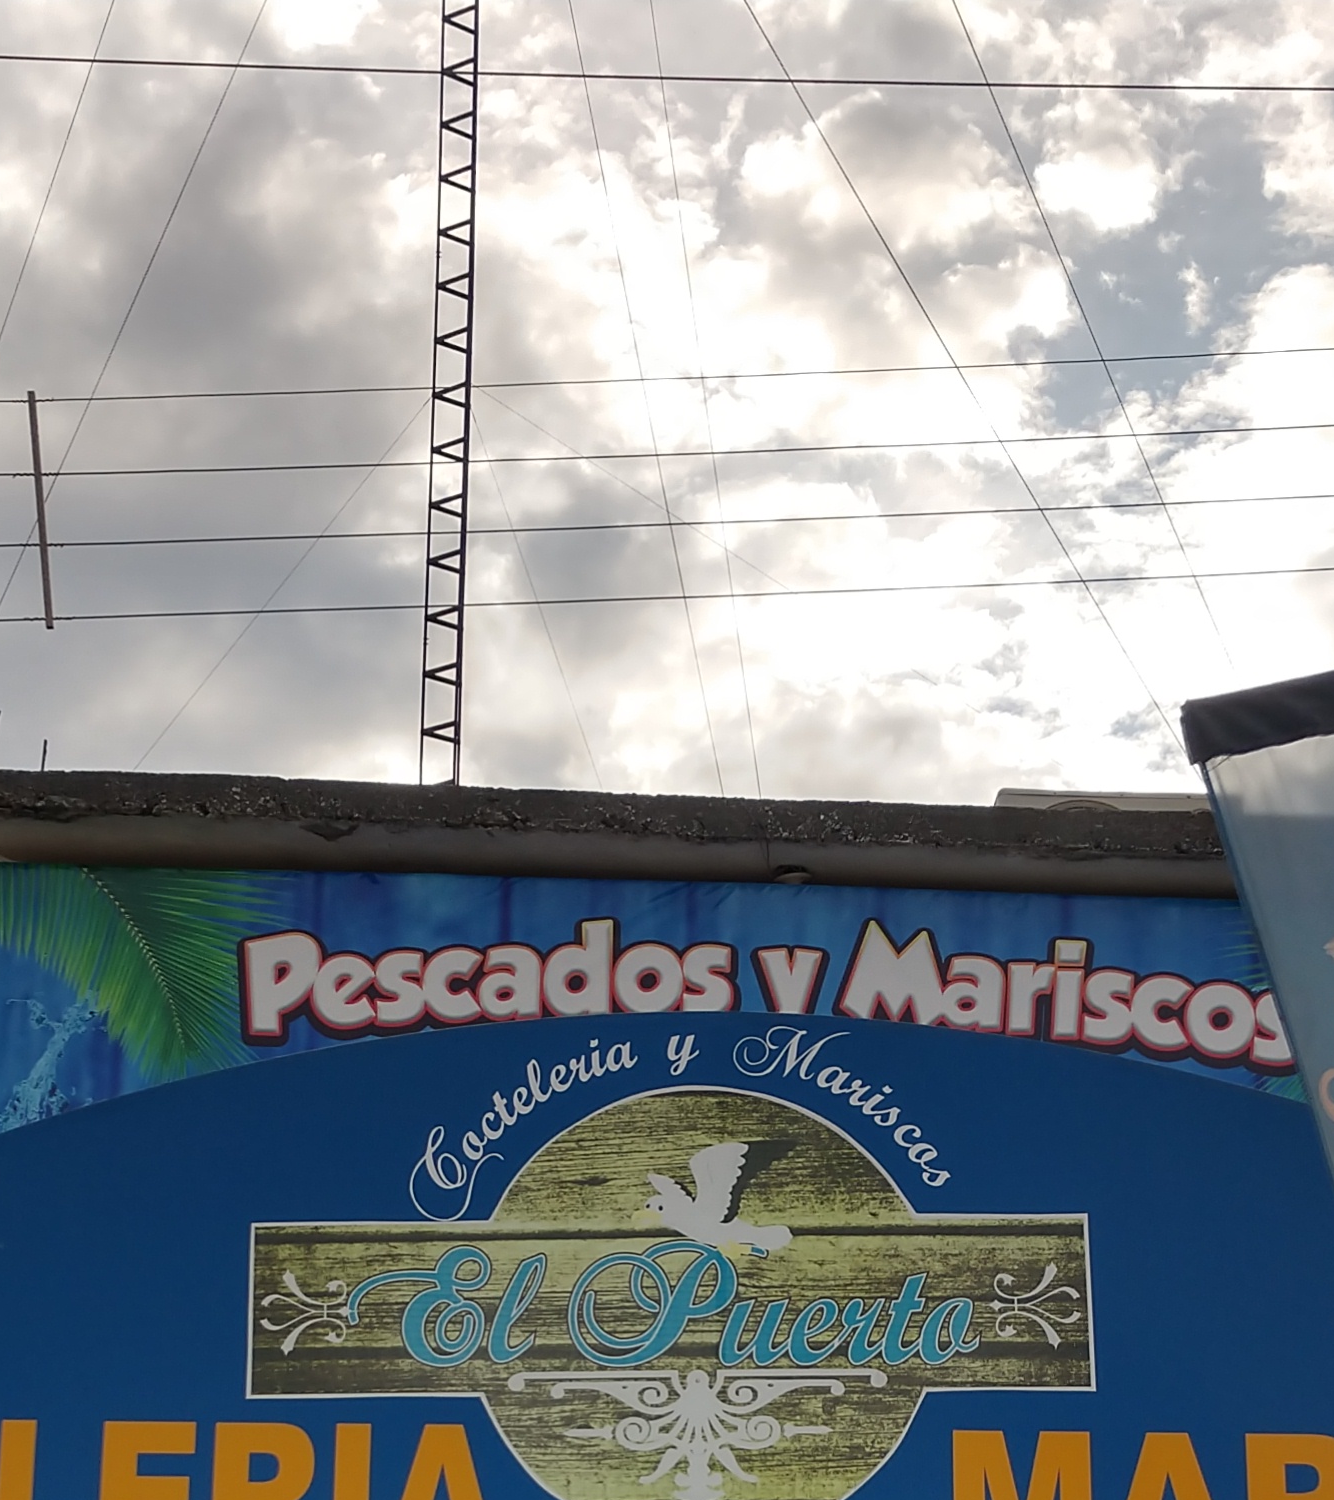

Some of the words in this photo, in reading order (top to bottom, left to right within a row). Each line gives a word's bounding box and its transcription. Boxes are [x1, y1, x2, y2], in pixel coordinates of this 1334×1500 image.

[240, 916, 737, 1042] Pescados
[835, 918, 1297, 1070] Mariscos
[409, 1037, 638, 1221] Cocteleria
[667, 1034, 699, 1075] y
[732, 1025, 951, 1187] Mariscos
[347, 1243, 548, 1368] El
[566, 1238, 982, 1368] Puerto
